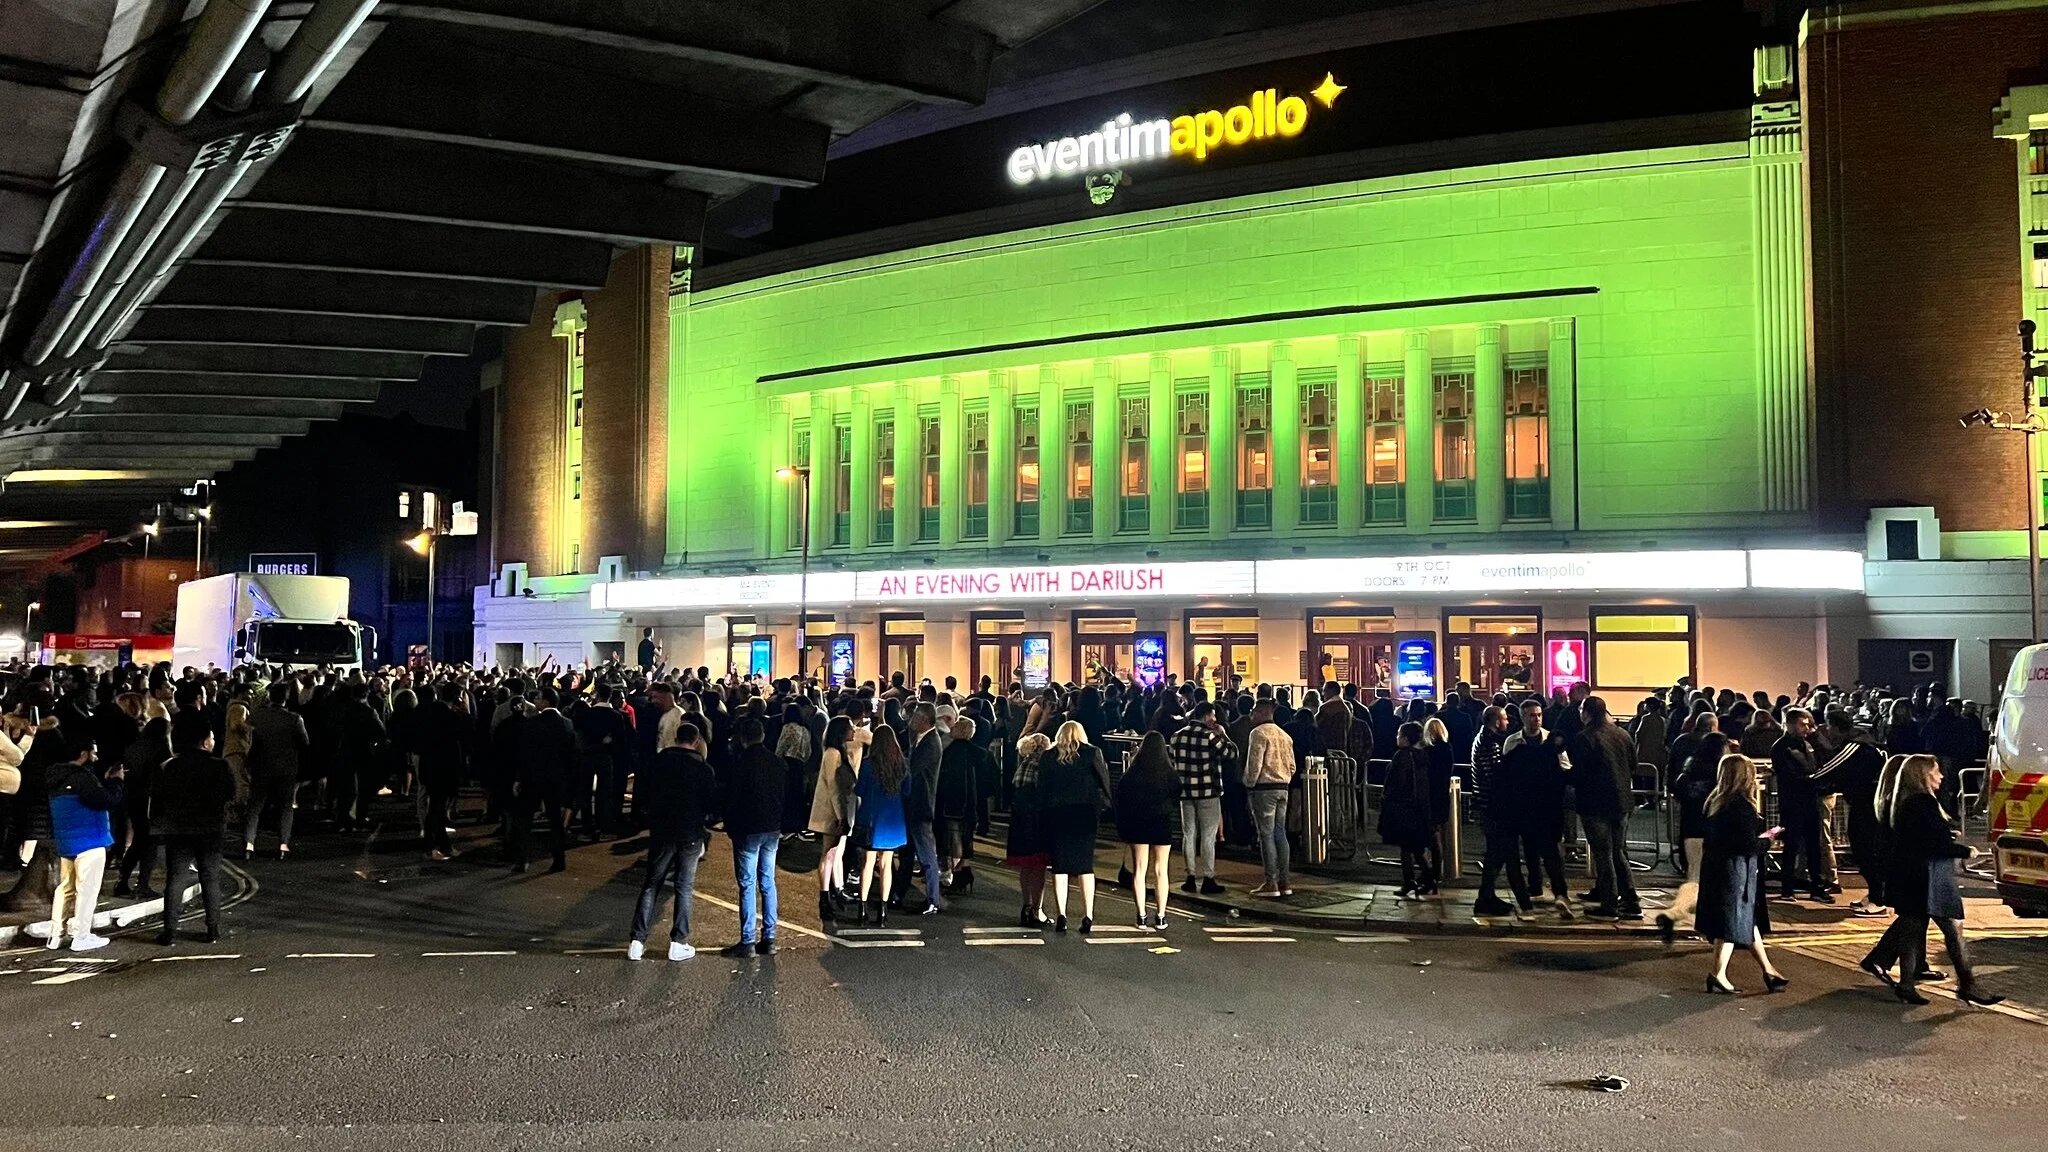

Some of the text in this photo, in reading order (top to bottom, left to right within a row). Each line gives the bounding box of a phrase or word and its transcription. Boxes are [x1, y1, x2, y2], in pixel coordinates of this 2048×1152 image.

[1008, 88, 1308, 184] eventimapollo
[257, 563, 308, 575] BURGERS
[1481, 561, 1585, 580] eventimapollo
[879, 569, 1164, 595] AN EVENING WITH DARIUSH
[1364, 576, 1406, 587] DOORS
